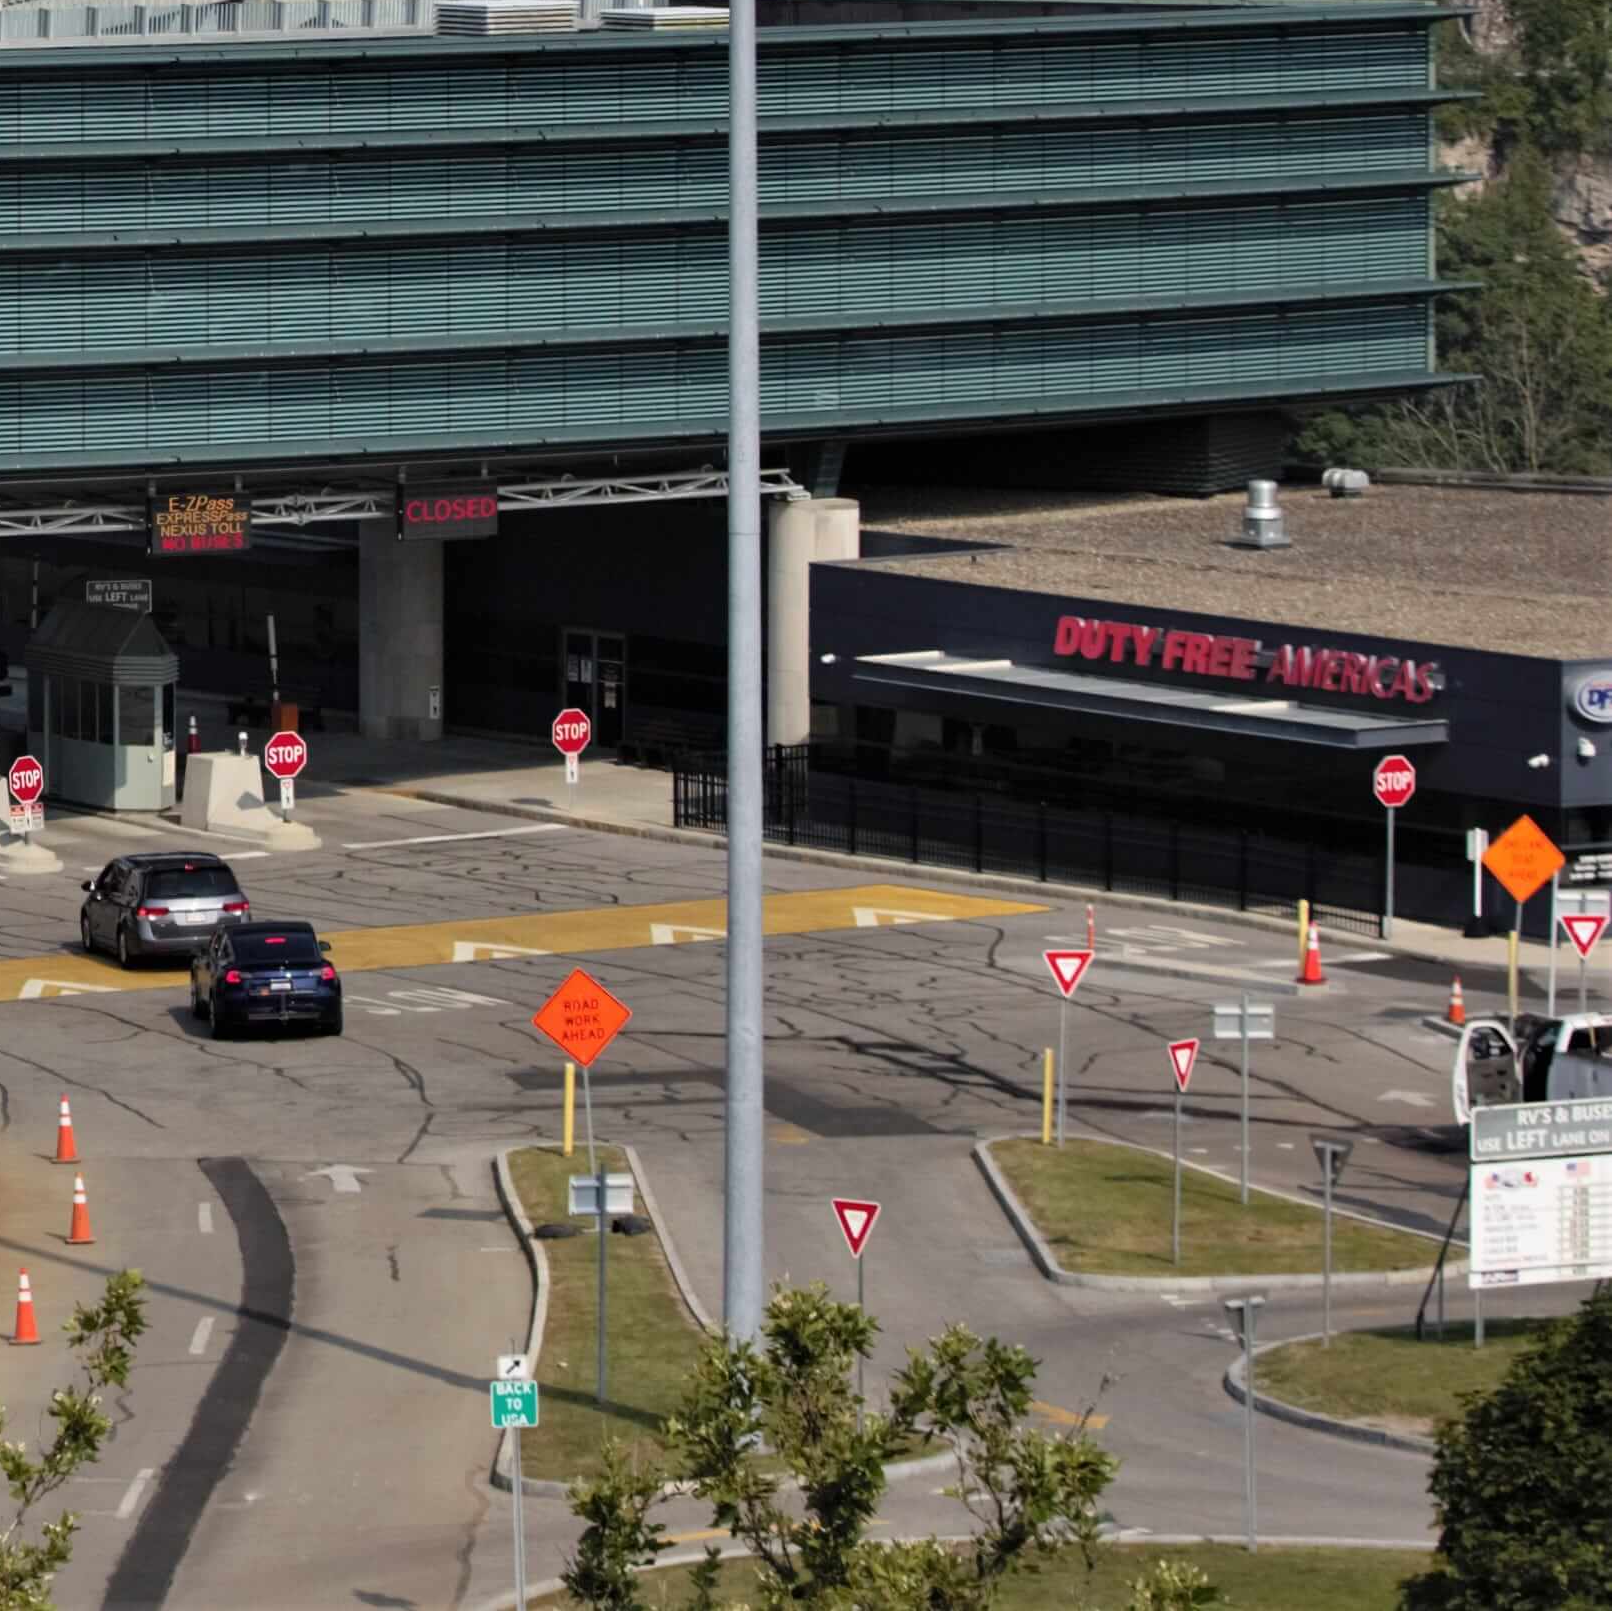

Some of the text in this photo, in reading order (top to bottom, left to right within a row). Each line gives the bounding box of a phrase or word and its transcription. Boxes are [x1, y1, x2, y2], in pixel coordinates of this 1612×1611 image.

[168, 496, 234, 512] E-ZPass
[405, 497, 497, 523] CLOSED
[156, 511, 249, 525] EXPRESSPass
[160, 523, 244, 537] NEXUS TOLL
[105, 591, 127, 602] LEFT
[1053, 616, 1440, 704] DUTY FREE AMERICAS
[556, 722, 588, 740] STOP
[269, 746, 302, 764] STOP
[12, 769, 40, 789] STOP
[1377, 771, 1412, 792] STOP
[564, 998, 599, 1012] ROAD
[566, 1014, 599, 1026] WORK
[562, 1028, 605, 1042] AHEAD
[1517, 1109, 1552, 1125] RV'S
[1555, 1107, 1570, 1123] &
[1478, 1129, 1609, 1152] USE LEFT LANE ON
[497, 1381, 532, 1396] BACK
[506, 1397, 522, 1410] TO
[501, 1413, 529, 1426] USA
